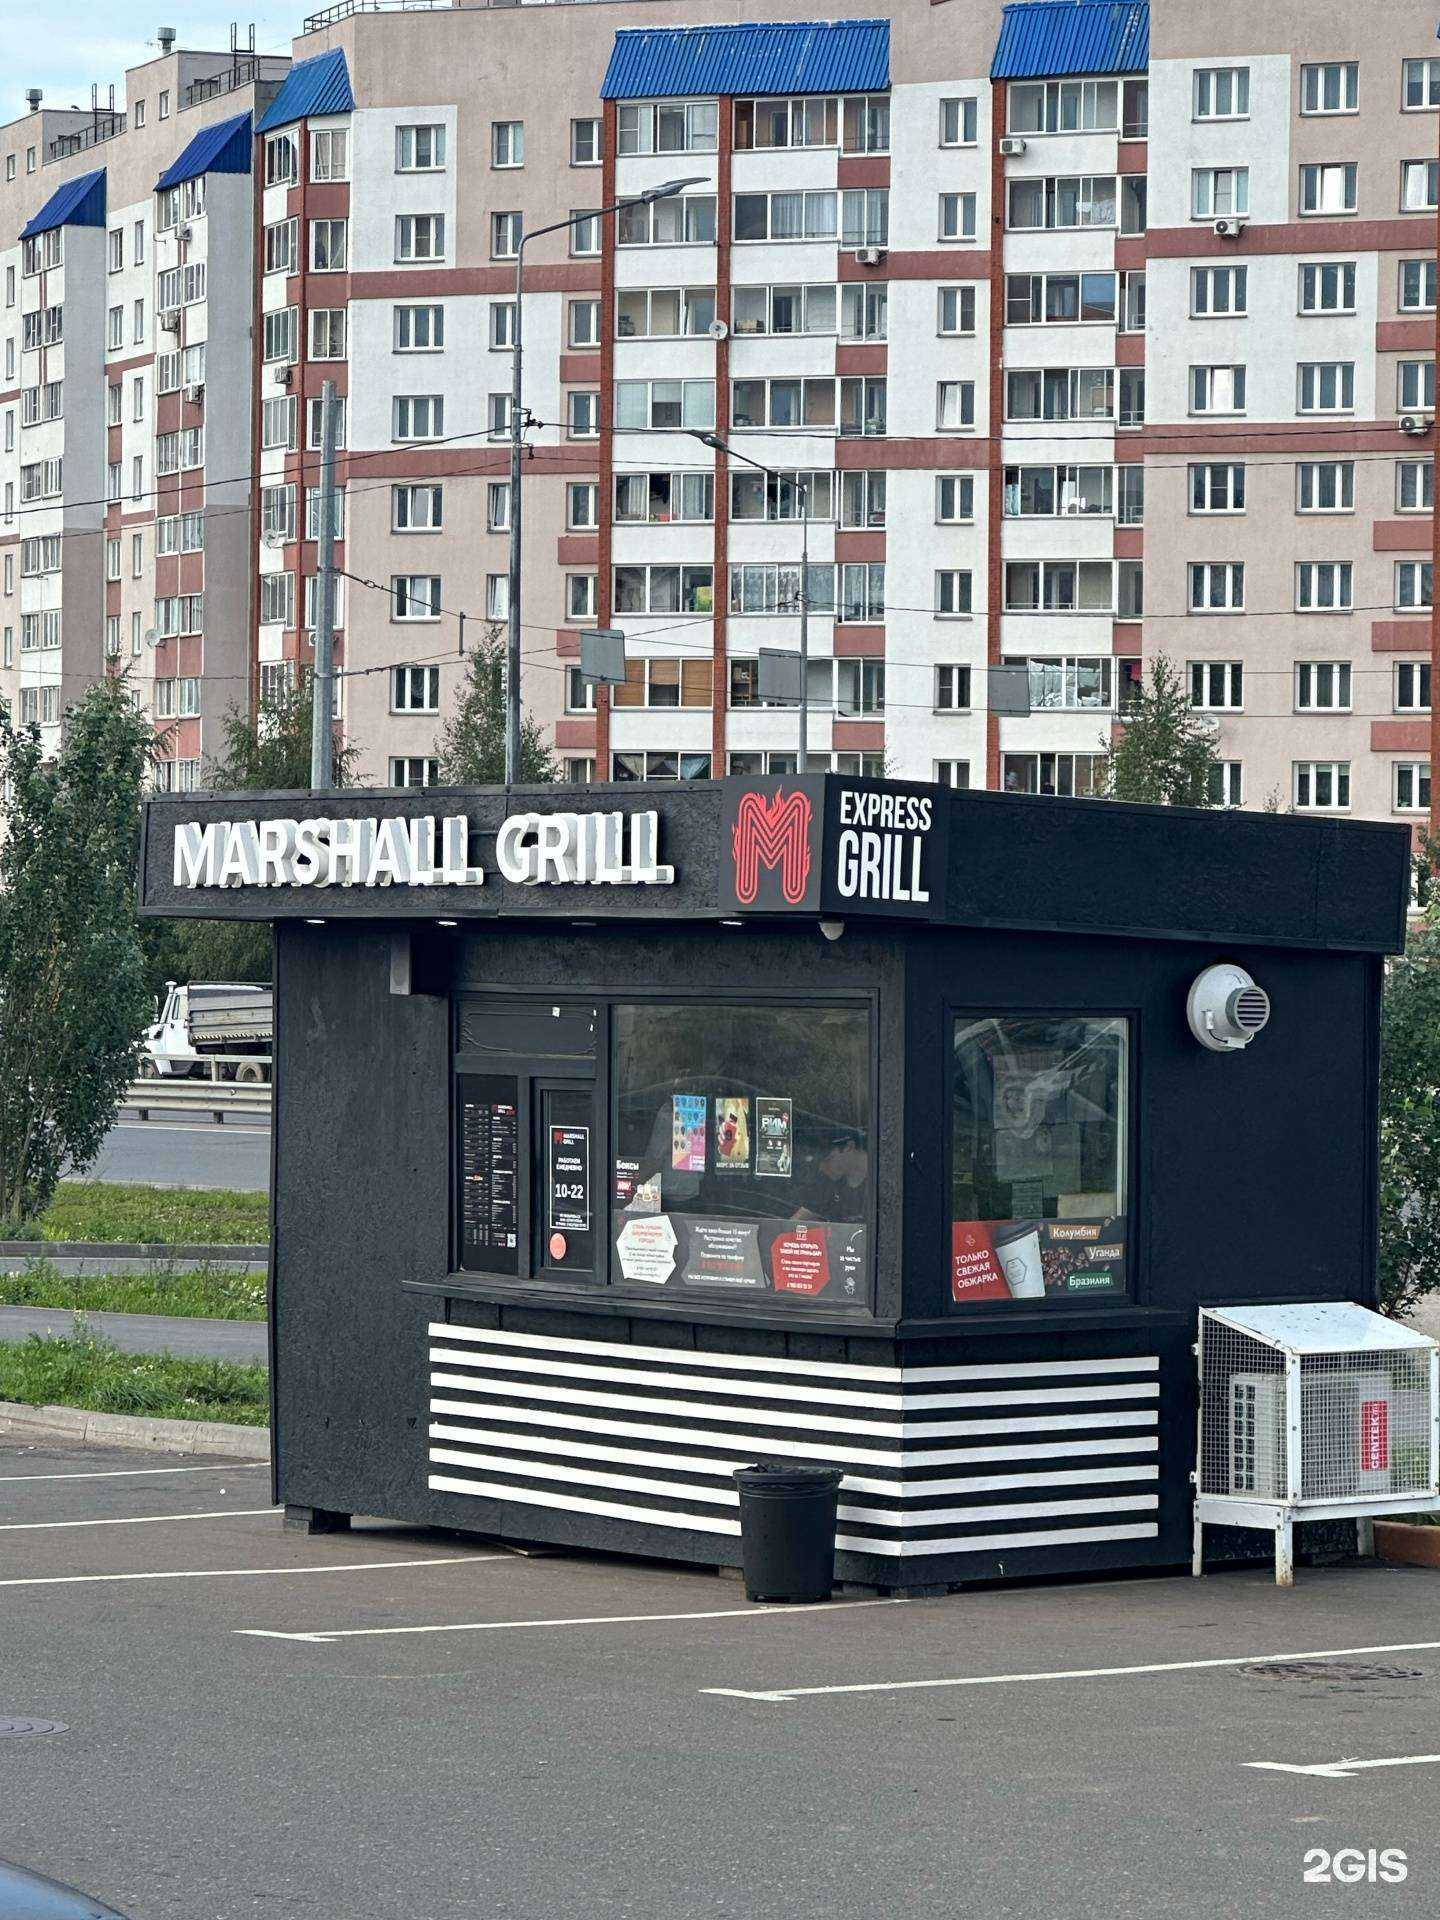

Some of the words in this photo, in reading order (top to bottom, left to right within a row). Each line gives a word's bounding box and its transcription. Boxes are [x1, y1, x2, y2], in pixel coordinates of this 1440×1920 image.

[840, 791, 932, 831] EXPRESS
[173, 815, 485, 888] MARSHALL
[496, 811, 675, 885] GRILL
[838, 829, 929, 903] GRILL
[555, 1183, 584, 1199] 10-22
[1053, 1226, 1097, 1240] Колумбия
[956, 1250, 989, 1265] ТОЛЬКО
[1089, 1247, 1120, 1260] Уганда
[957, 1262, 990, 1276] СВЕЖАЯ
[958, 1272, 999, 1289] ОБЖАРКА
[1069, 1275, 1110, 1289] Бразилия
